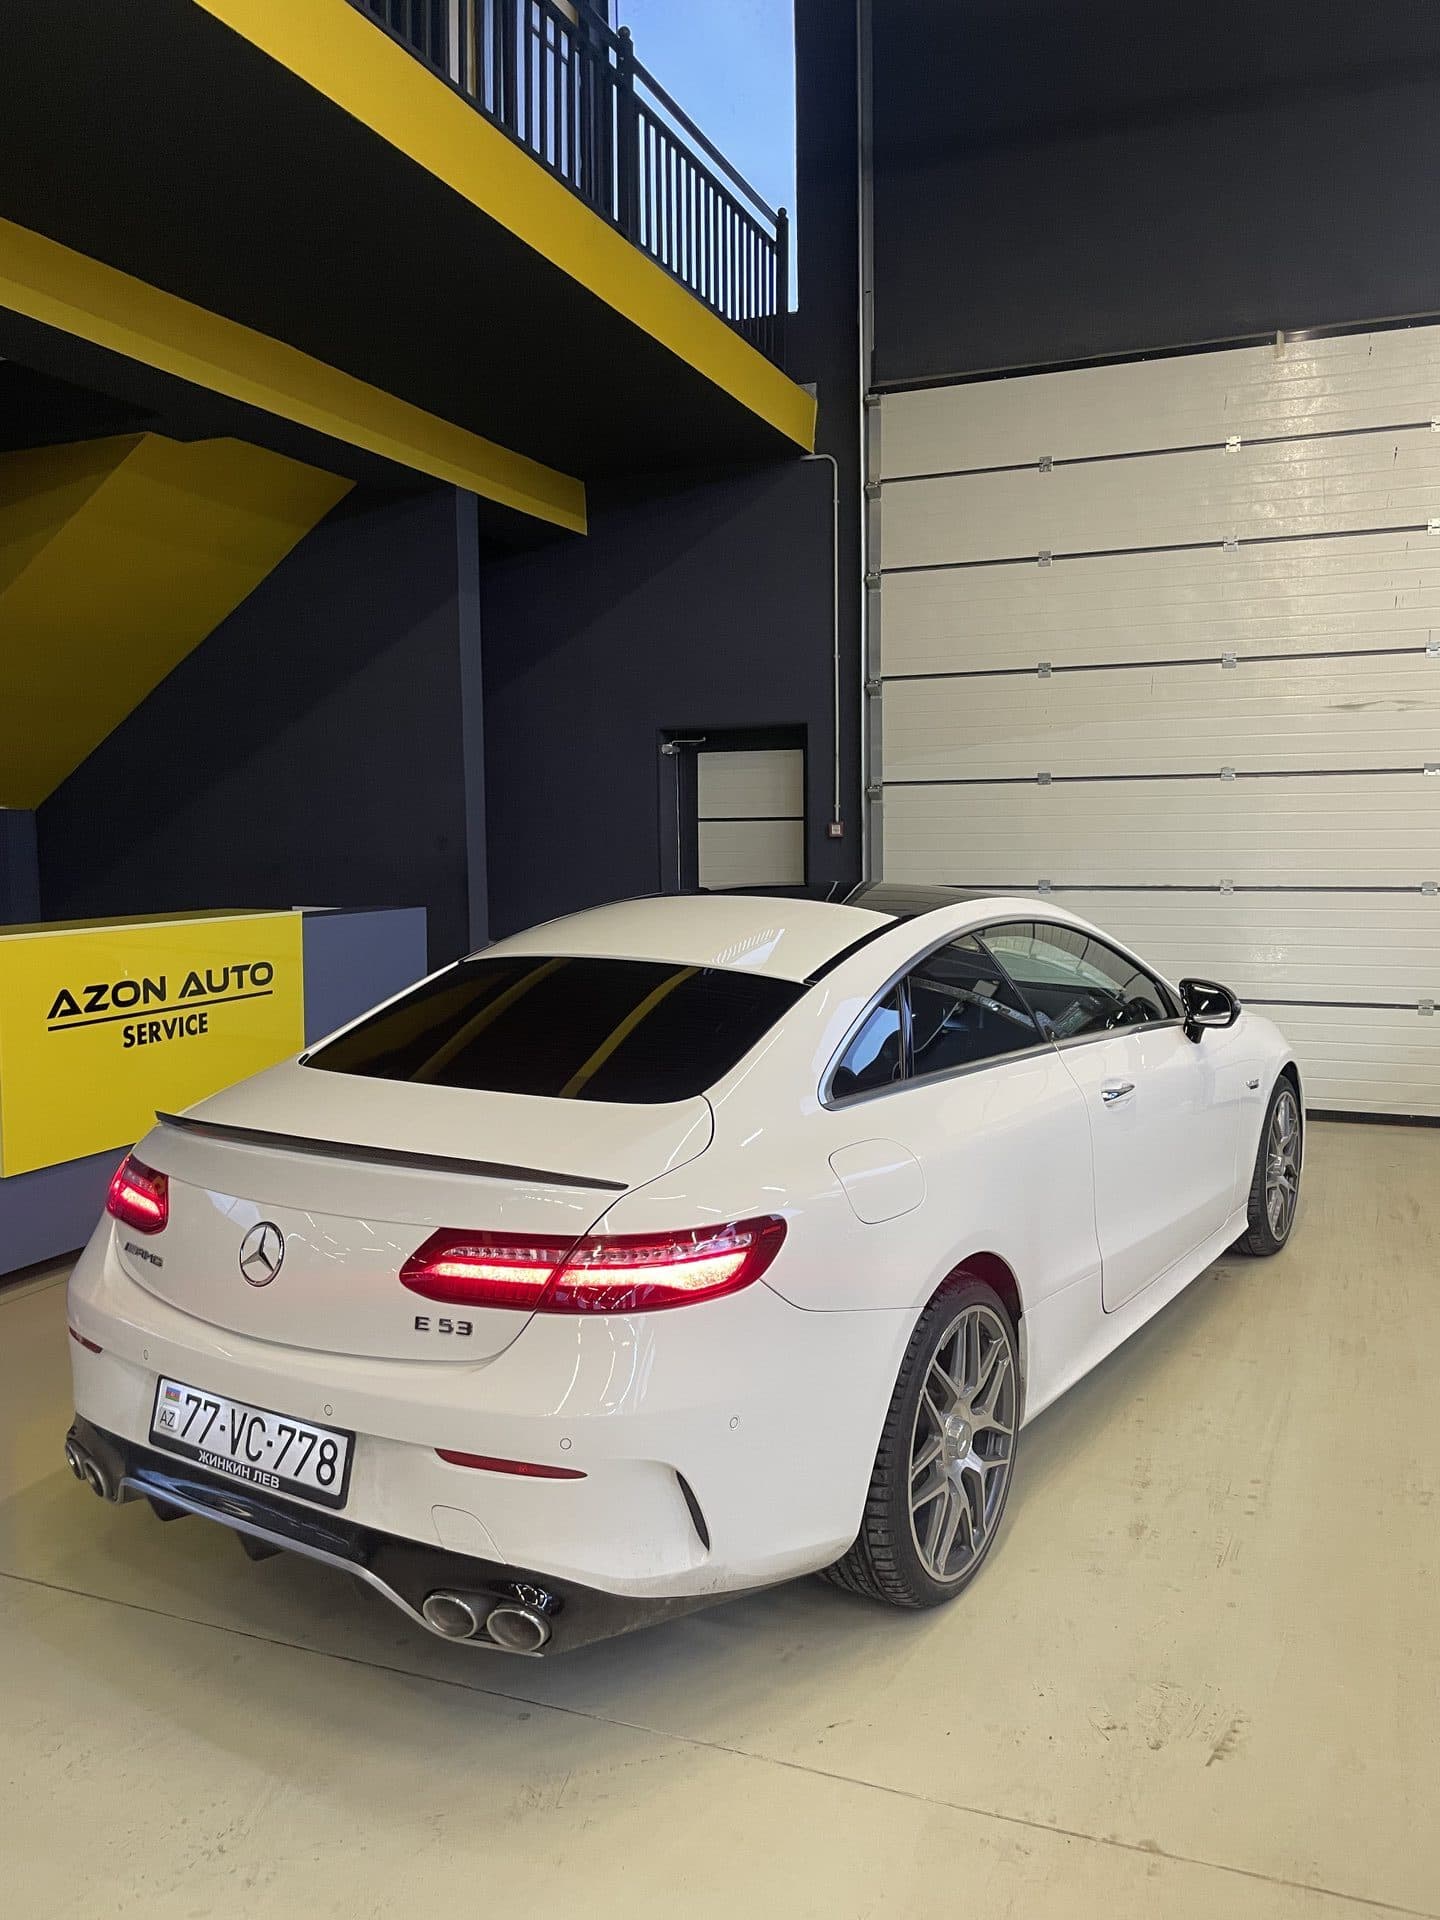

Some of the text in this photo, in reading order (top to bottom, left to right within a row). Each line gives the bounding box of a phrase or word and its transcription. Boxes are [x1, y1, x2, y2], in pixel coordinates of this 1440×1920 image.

[47, 961, 273, 1019] AZON AUTO
[123, 1012, 208, 1048] SERVICE
[415, 1316, 473, 1336] E 53
[160, 1410, 175, 1427] AZ
[198, 1449, 280, 1489] ЖИНКИН ЛЕВ
